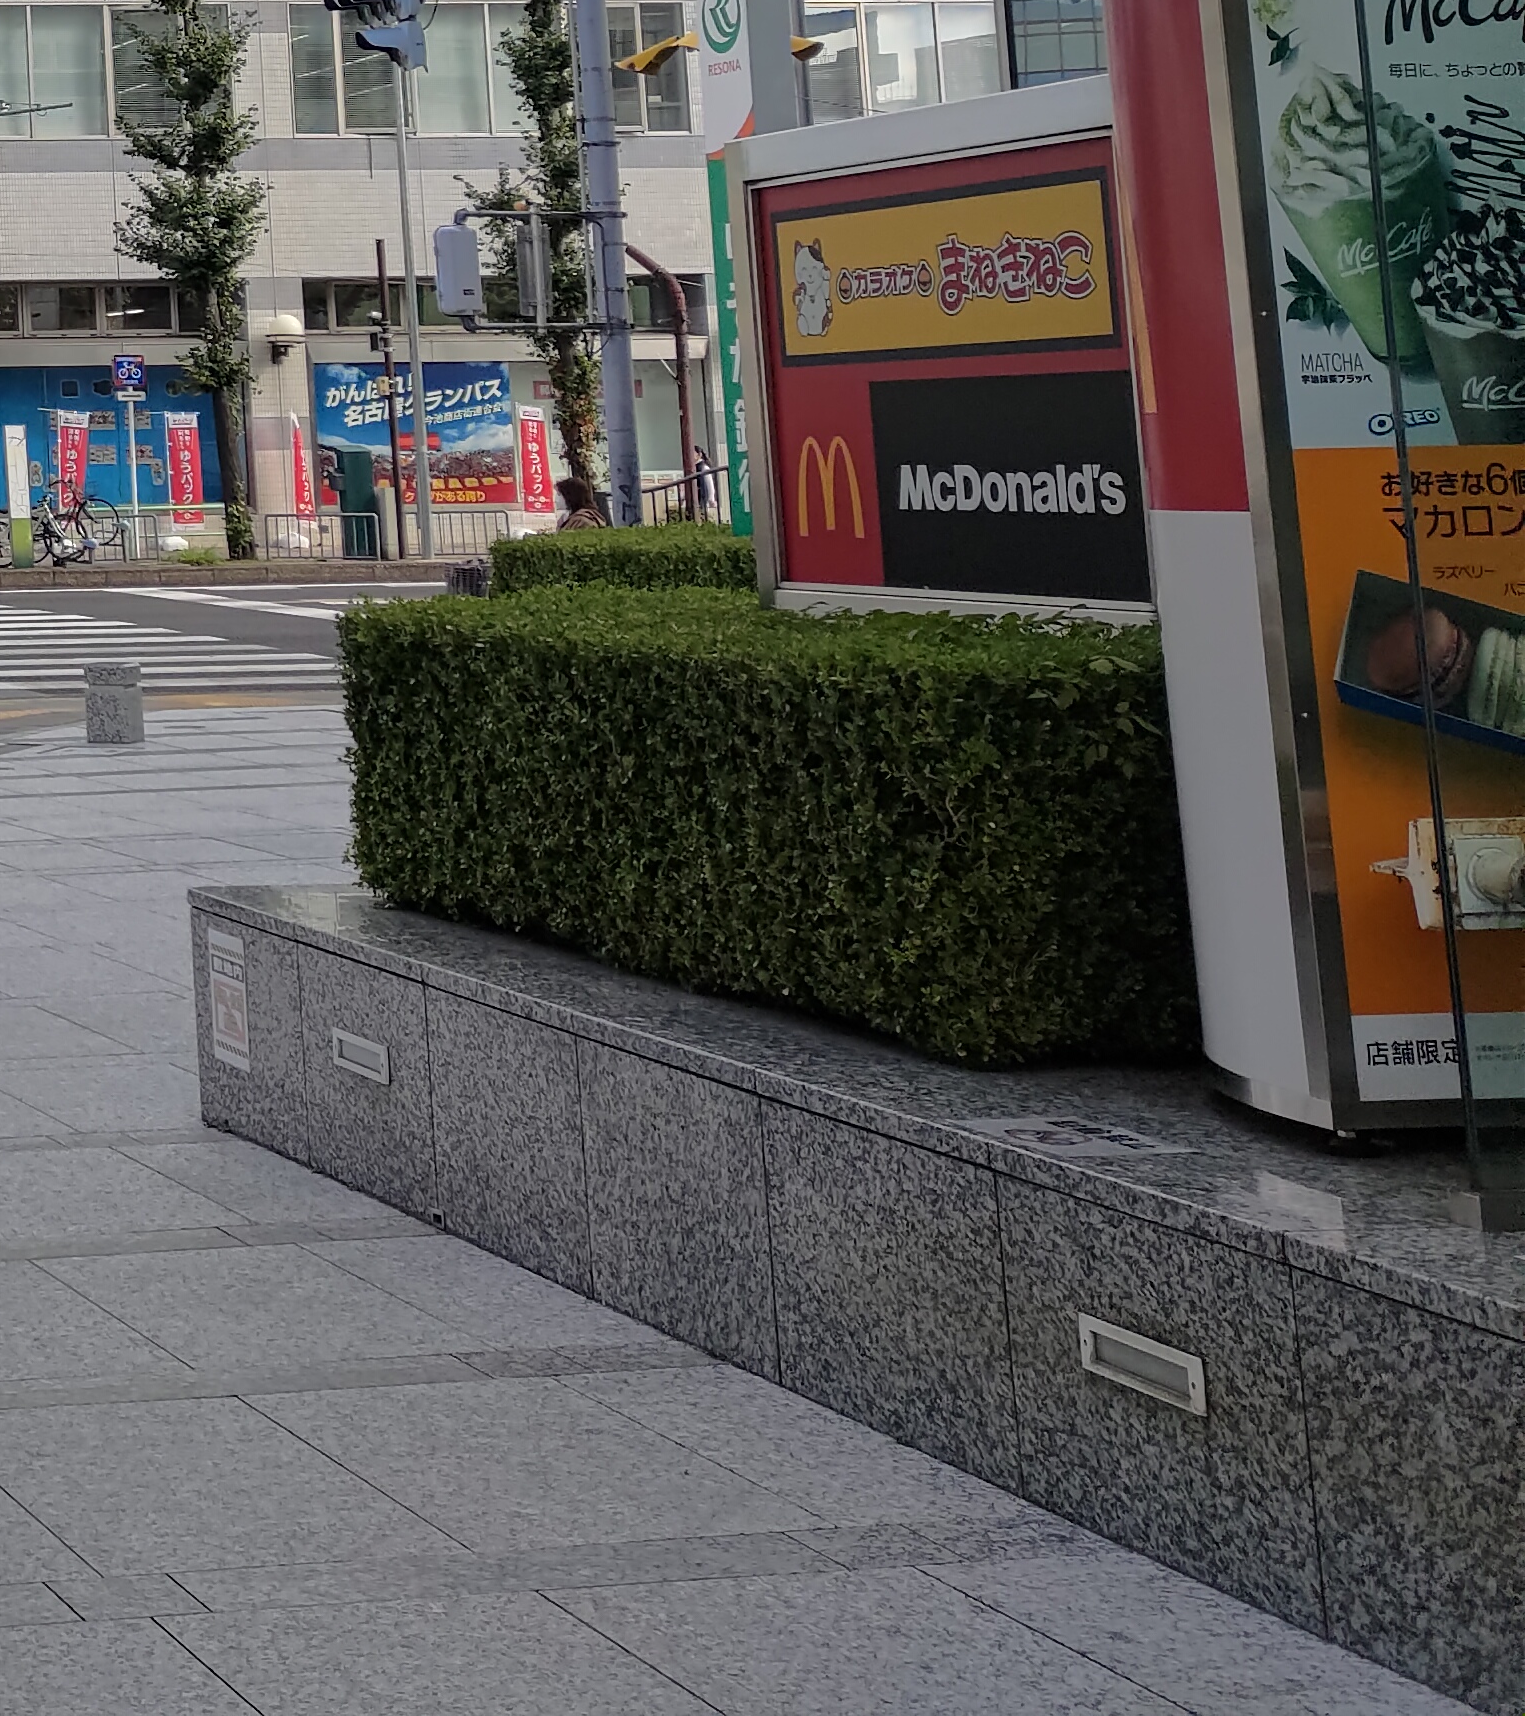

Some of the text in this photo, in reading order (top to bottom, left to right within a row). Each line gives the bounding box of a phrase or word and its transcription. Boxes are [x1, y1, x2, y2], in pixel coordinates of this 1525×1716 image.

[708, 59, 742, 77] RESONA
[853, 231, 1097, 315] カラオケ まねきねこ
[1301, 352, 1364, 372] MATCHA
[898, 464, 1127, 515] McDonald's
[1432, 565, 1496, 580] ラズベリー
[1366, 1038, 1460, 1067] 店舗限定
